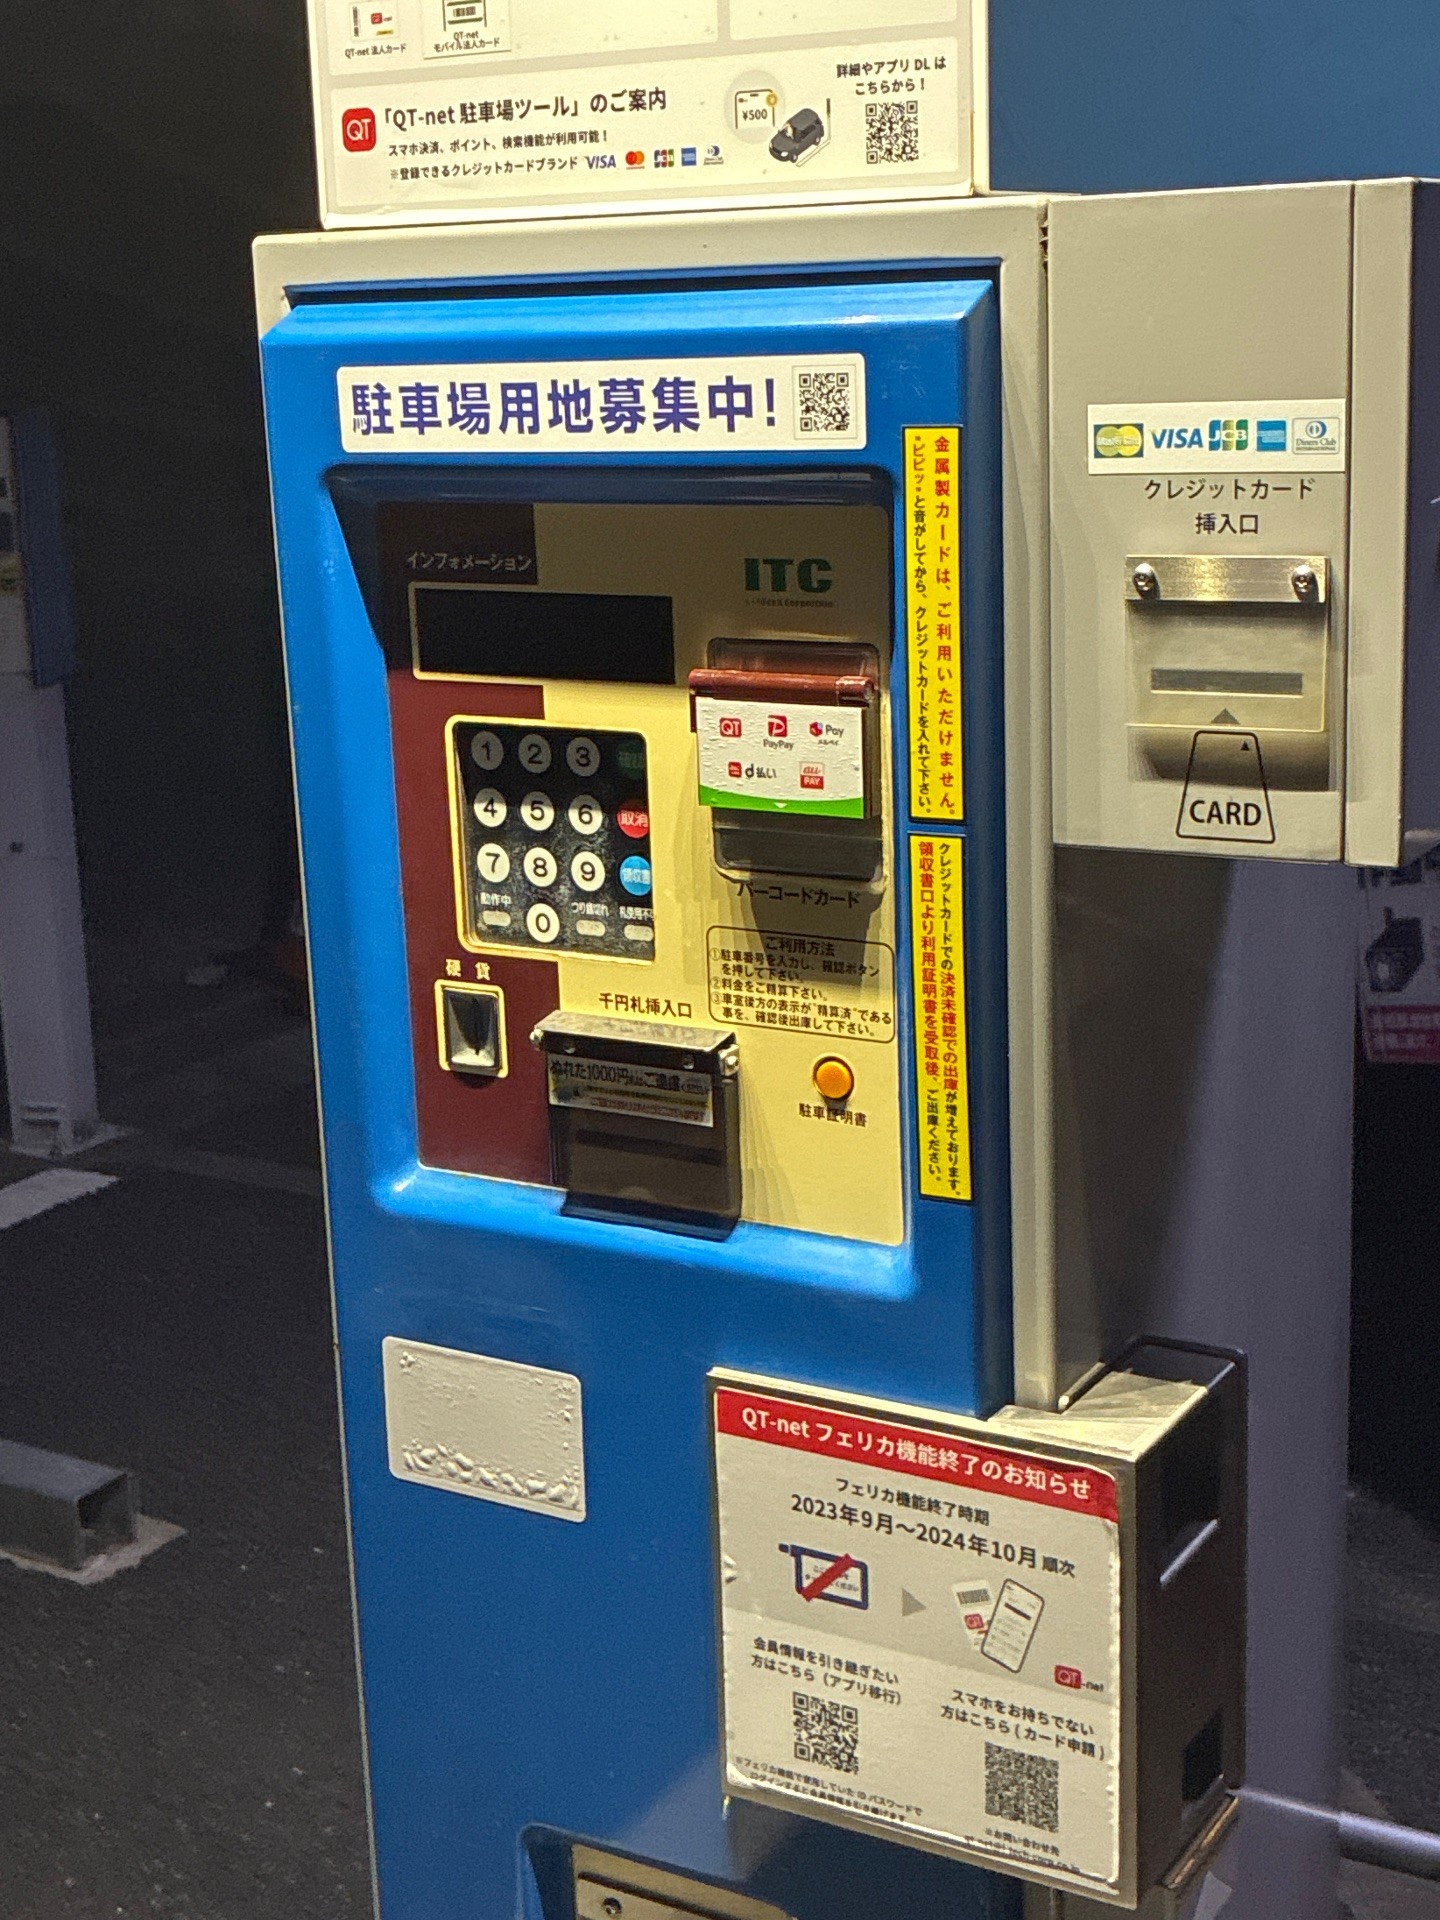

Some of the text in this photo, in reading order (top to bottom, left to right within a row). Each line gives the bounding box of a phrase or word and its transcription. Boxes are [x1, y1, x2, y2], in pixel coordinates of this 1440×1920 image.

[836, 56, 947, 78] 詳細やアプリ DL は
[742, 108, 769, 121] ¥500
[346, 118, 372, 141] QT
[586, 154, 617, 170] VISA
[1151, 428, 1204, 449] VISA
[1144, 478, 1315, 500] クレジットカード
[1195, 513, 1259, 535] 挿入口
[407, 551, 532, 571] インフォメーション
[744, 558, 832, 593] ITC
[721, 720, 740, 736] QT
[825, 724, 844, 738] Pay
[483, 741, 491, 761] 1
[527, 744, 542, 764] 2
[763, 739, 794, 751] PayPay
[575, 747, 590, 767] 3
[803, 778, 821, 786] PAY
[483, 798, 498, 818] 4
[530, 801, 545, 821] 5
[578, 804, 593, 824] 6
[1190, 800, 1261, 826] CARD
[486, 853, 500, 873] 7
[533, 857, 548, 877] 8
[580, 862, 595, 881] 9
[737, 882, 860, 908] バーコードカード
[535, 913, 550, 933] 0
[765, 937, 835, 957] ご利用方法
[599, 992, 692, 1018] 千円札挿入口
[799, 1103, 867, 1127] 駐車証明書
[741, 1406, 1092, 1501] QT-net フェリカ機能終了のお知らせ
[836, 1478, 990, 1526] フェリカ機能終了時期
[1042, 1554, 1076, 1579] 順次
[754, 1636, 899, 1684] 会員情報を引き継ぎたい
[952, 1689, 1095, 1736] スマホをお持ちでない
